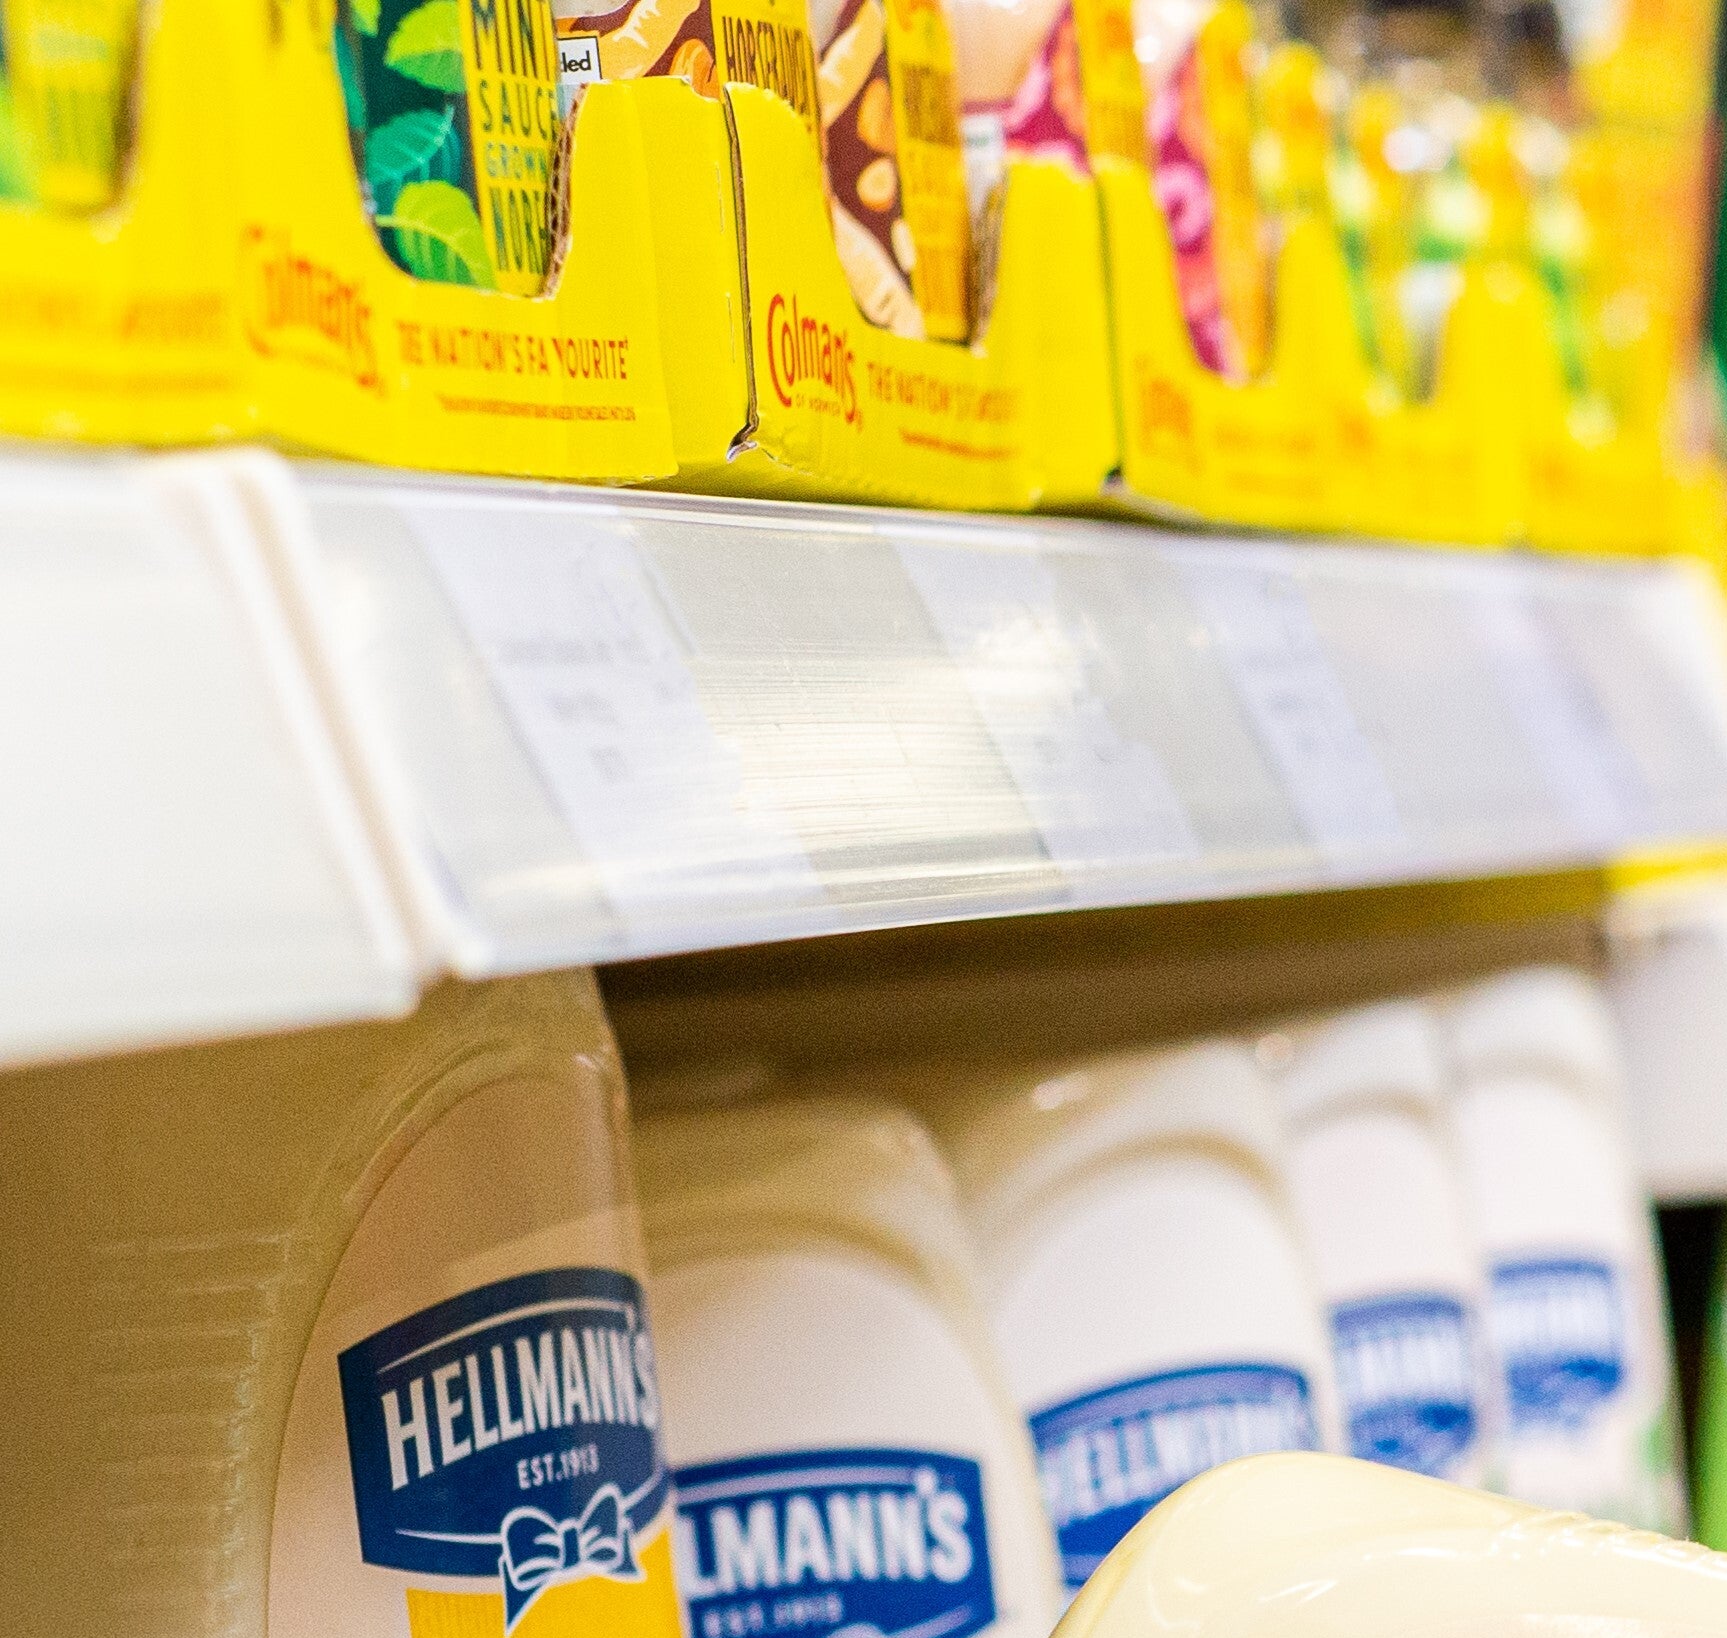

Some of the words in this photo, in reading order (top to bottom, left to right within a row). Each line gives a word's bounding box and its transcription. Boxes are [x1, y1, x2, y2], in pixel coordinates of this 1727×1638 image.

[767, 293, 856, 424] Colman's
[381, 1305, 657, 1492] HELLMANN'S
[679, 1466, 973, 1598] LMANN'S
